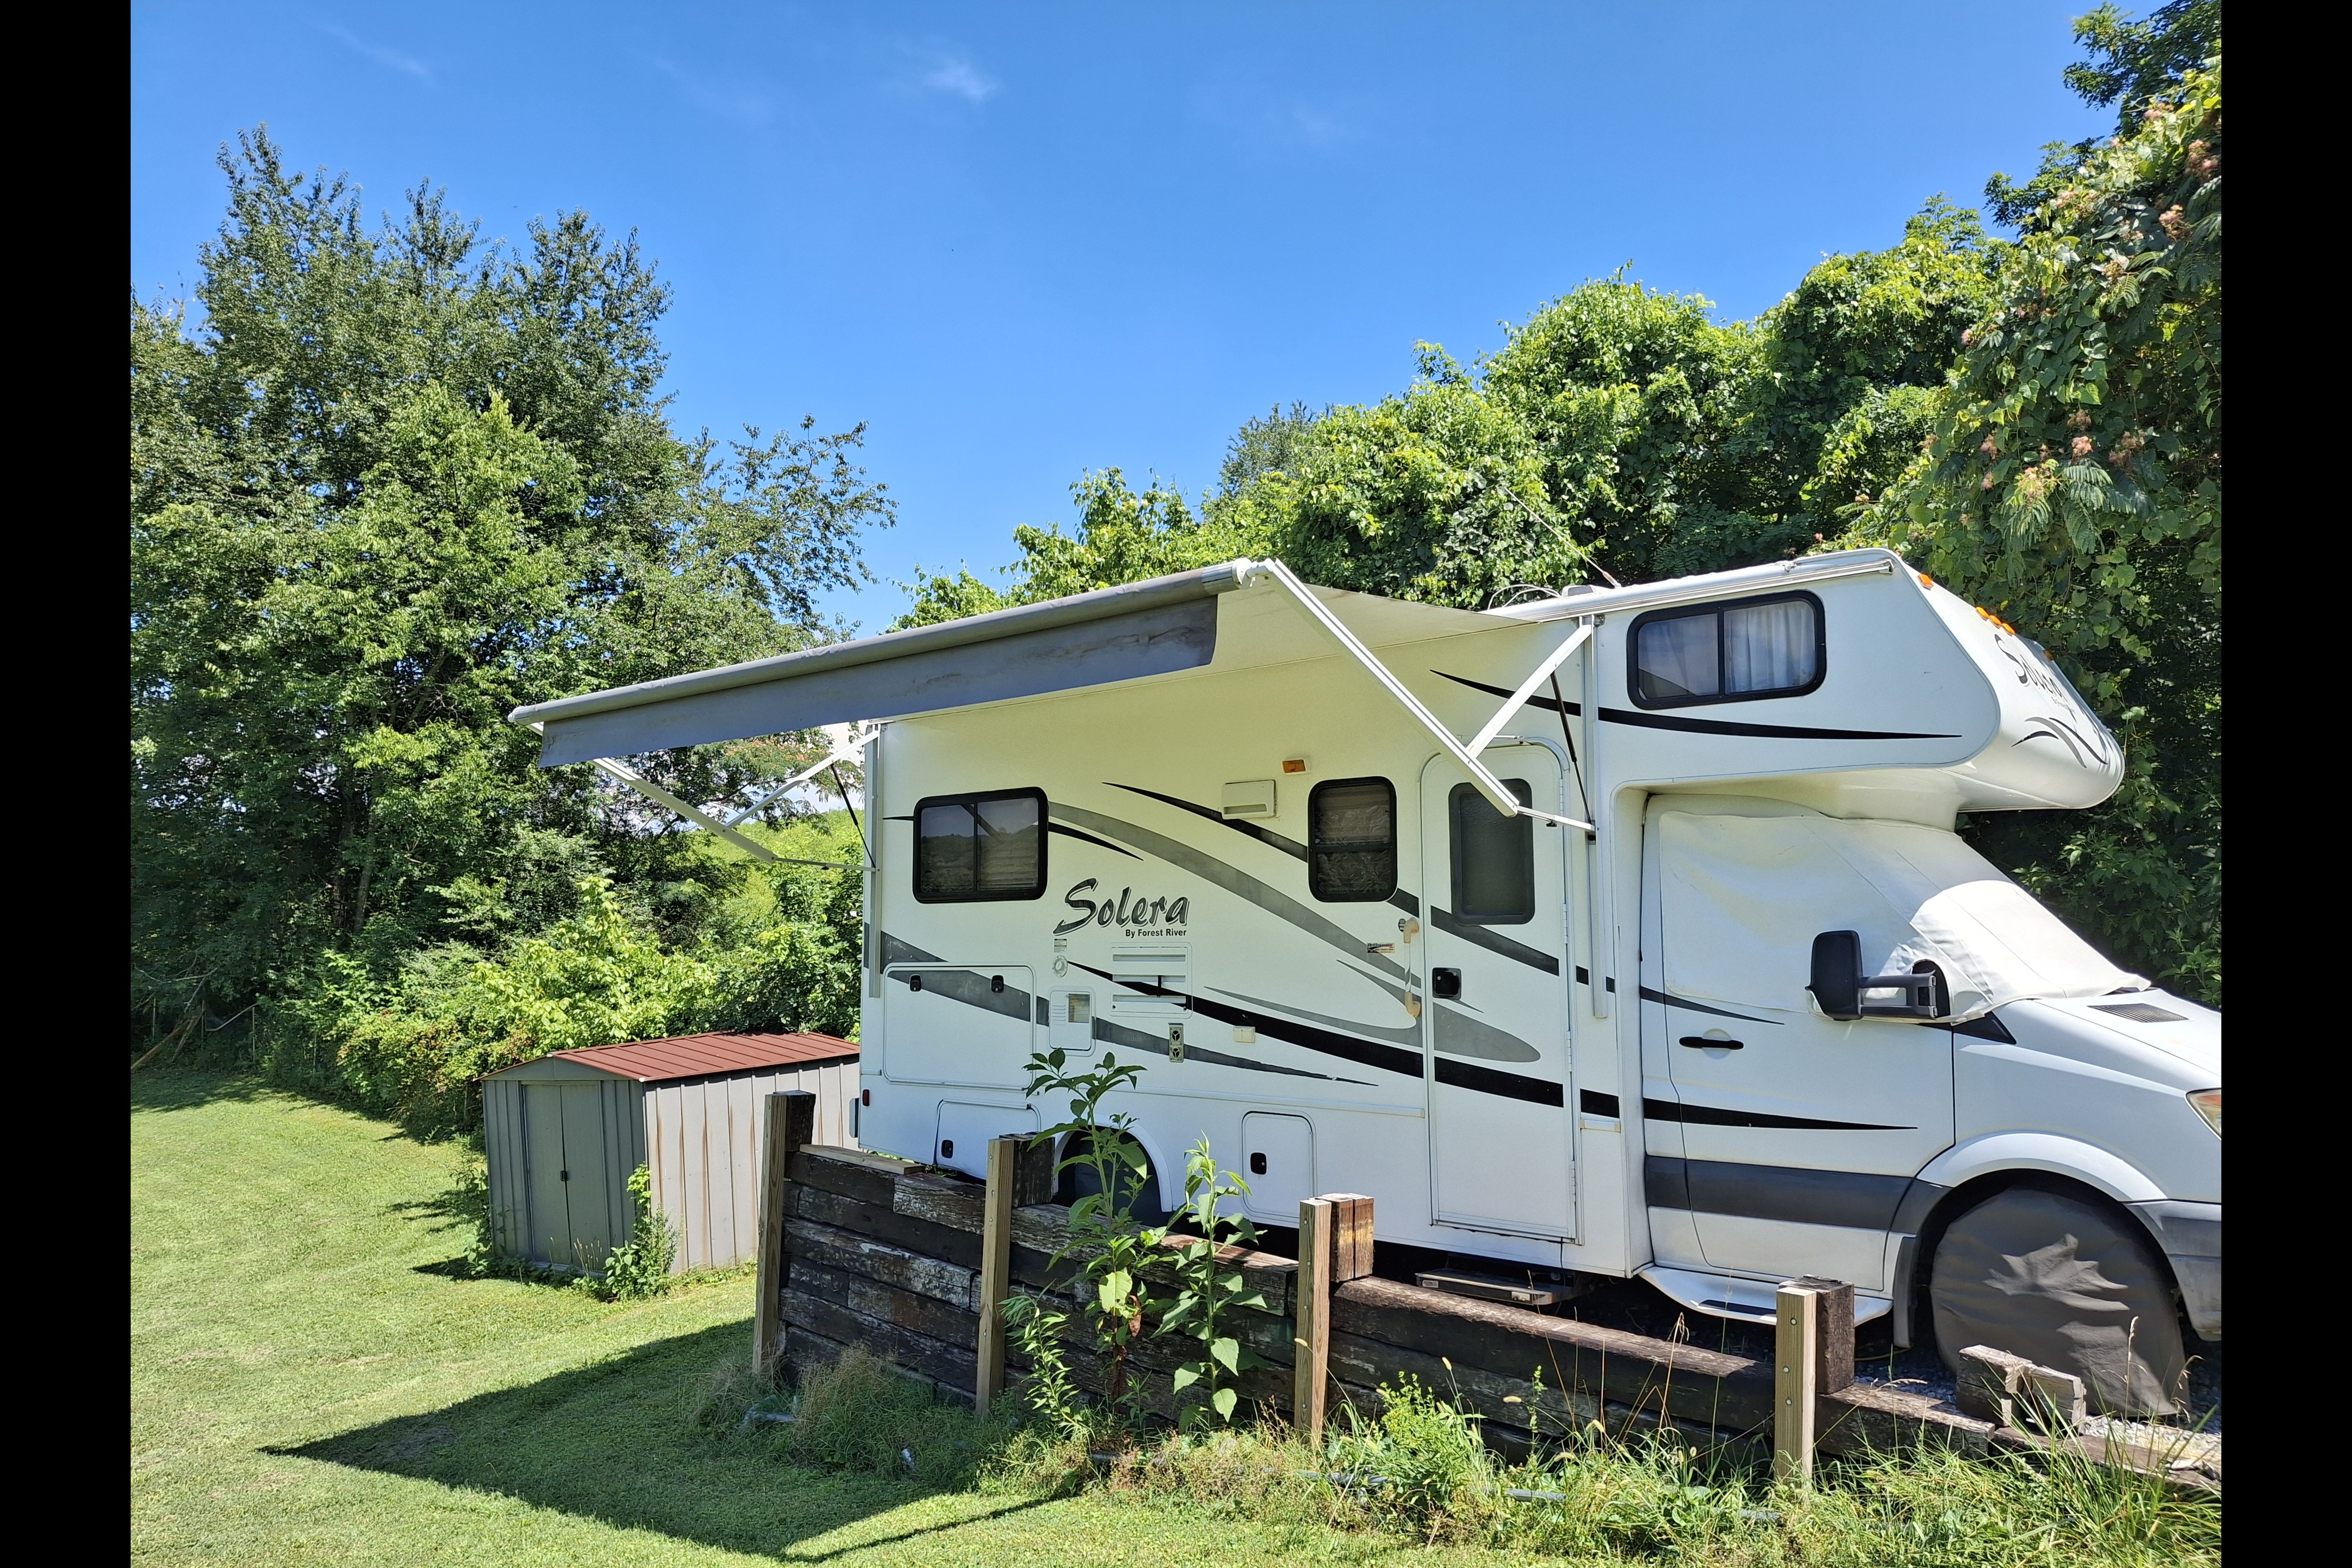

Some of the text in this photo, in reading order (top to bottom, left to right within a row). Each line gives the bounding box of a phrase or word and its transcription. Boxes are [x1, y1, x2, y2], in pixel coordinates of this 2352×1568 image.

[1053, 878, 1189, 936] Solera
[1125, 930, 1134, 938] By
[1166, 928, 1187, 936] River
